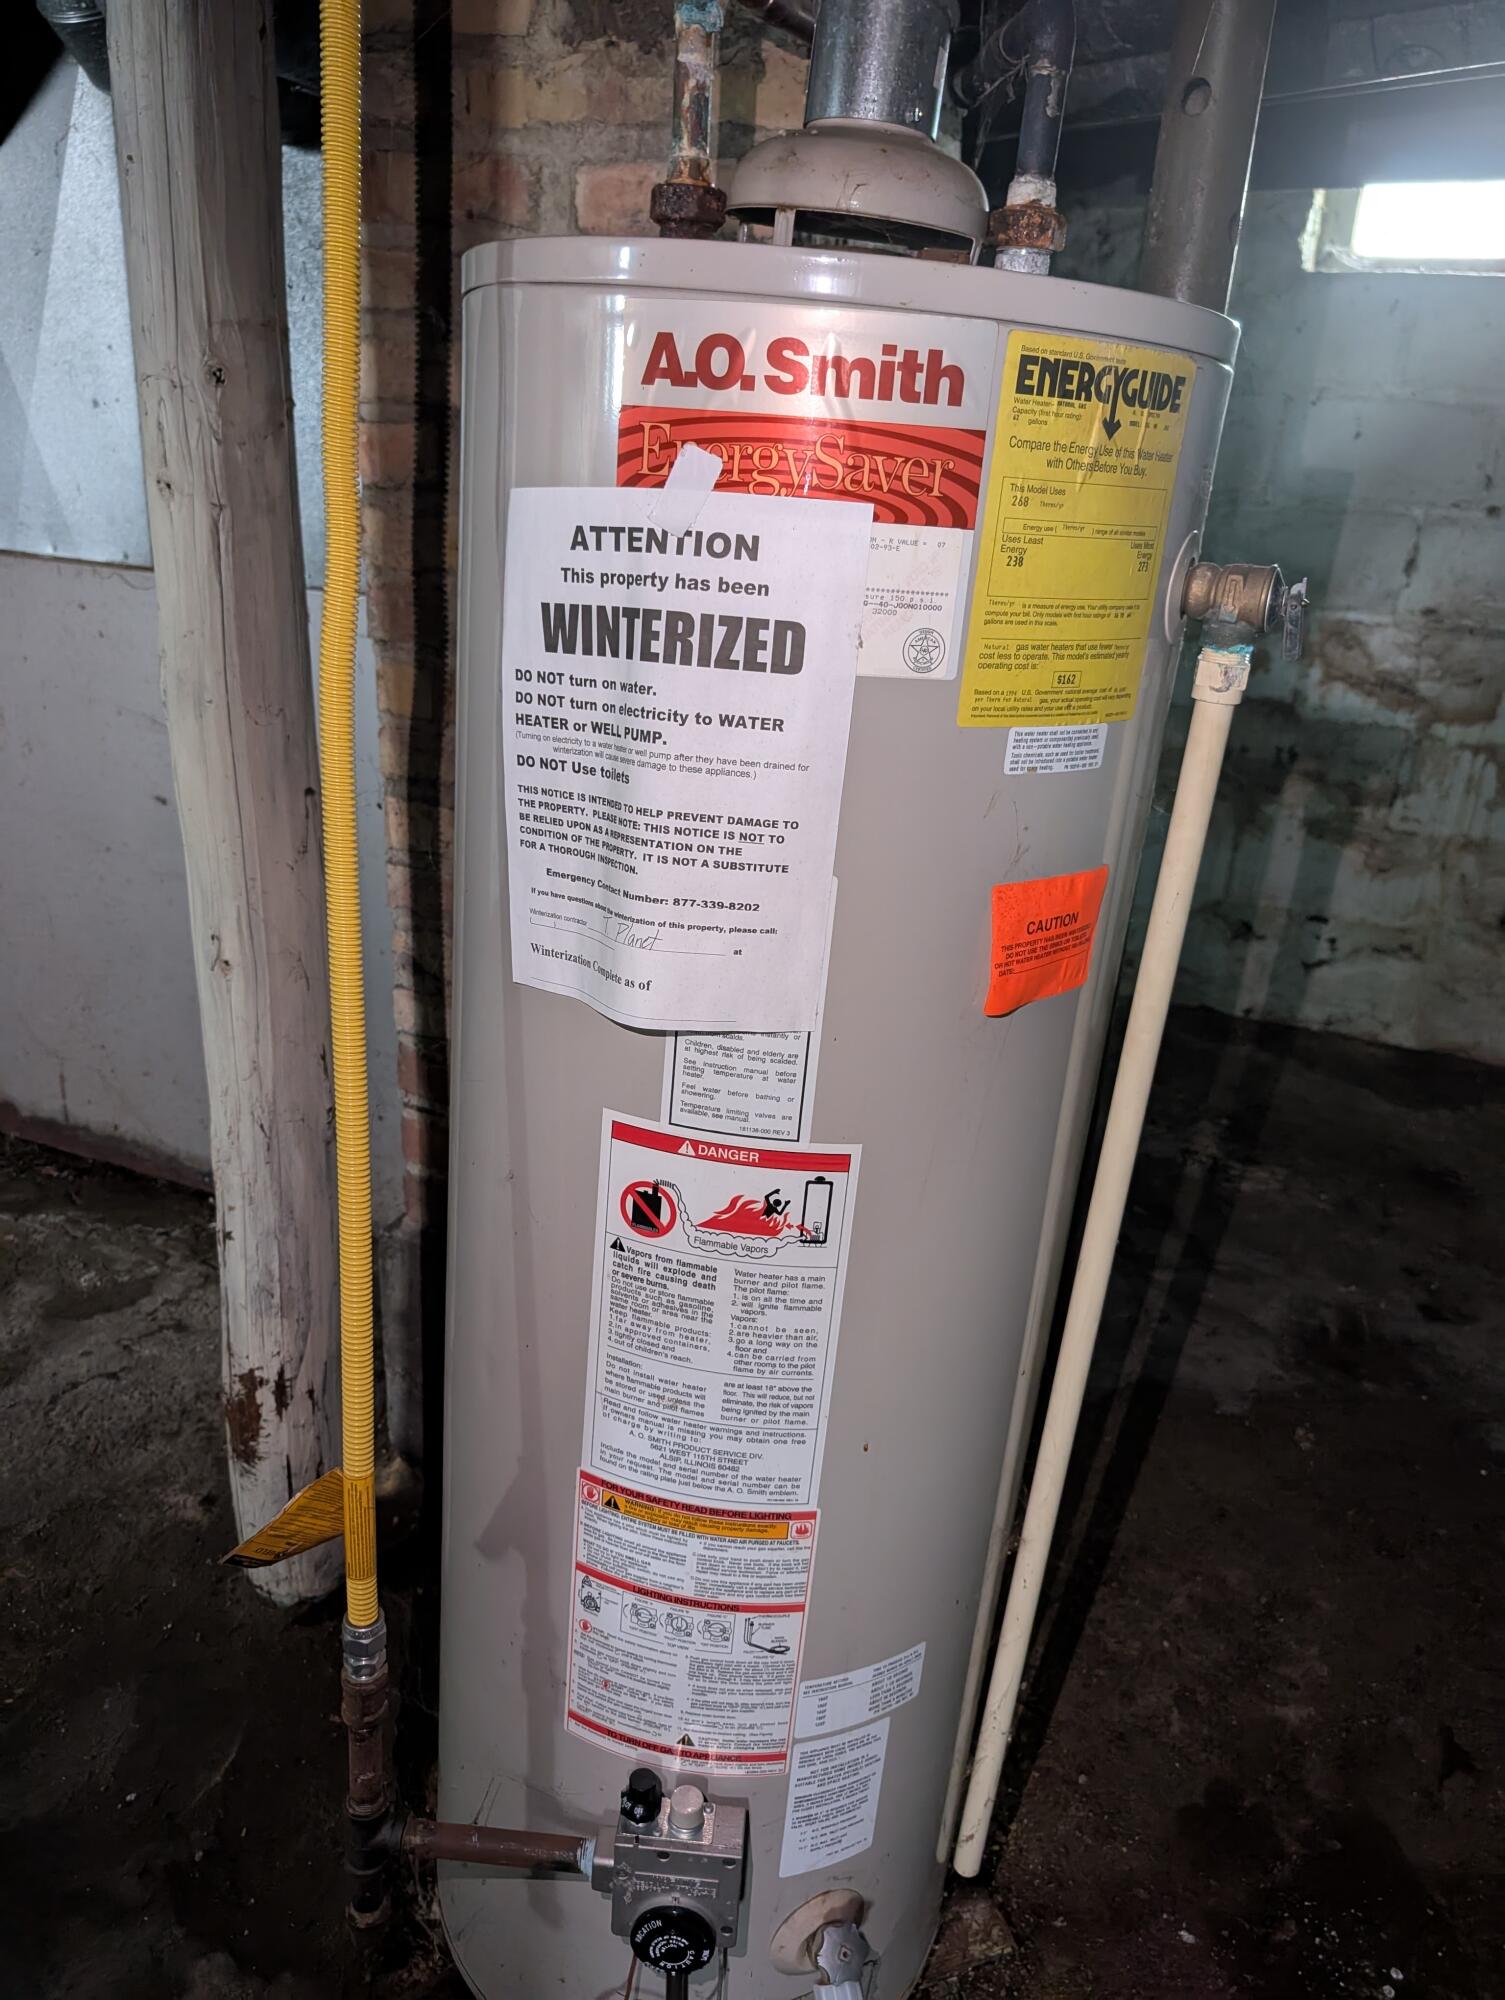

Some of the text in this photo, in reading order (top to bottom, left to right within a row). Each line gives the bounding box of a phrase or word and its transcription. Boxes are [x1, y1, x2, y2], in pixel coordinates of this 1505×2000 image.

[641, 332, 964, 406] A.O. Smith
[1015, 354, 1186, 413] ENERGYGUIDE
[638, 421, 955, 498] EergySaver
[1009, 435, 1173, 462] Compare the Energy Use of this Water Heater
[1046, 457, 1147, 477] with Others Before You Buy.
[1010, 483, 1066, 495] This Model Uses
[1011, 496, 1029, 507] 268
[570, 525, 760, 561] ATTENTION
[1000, 545, 1027, 556] Energy
[1001, 534, 1044, 544] Uses Least
[1006, 556, 1023, 567] 238
[1138, 562, 1149, 572] 273
[561, 568, 770, 596] This property has been
[541, 602, 806, 675] WINTERIZED
[978, 662, 1039, 671] operating cost is:
[1057, 674, 1075, 684] $162
[516, 669, 657, 696] DO NOT turn on water.
[516, 692, 784, 732] DO NOT turn on electricity to WATER
[516, 713, 668, 745] HEATER or WELL PUMP.
[517, 755, 630, 784] DO NOT Use toilets
[518, 785, 799, 830] THIS NOTICE IS INTENDED TO HELP PREVENT DAMAGE TO
[518, 798, 785, 844] THE PROPERTY. PLEASE NOTE: THIS NOTICE IS NOT TO
[519, 812, 742, 856] BE RELIED UPON AS A REPRESENTATION ON THE
[520, 826, 789, 874] CONDITION OF THE PROPERTY. IT IS NOT A SUBSTITUTE
[520, 839, 638, 875] FOR A THOROUGH INSPECTION.
[546, 868, 760, 912] Emergency Contact Number: 877-339-8202
[1027, 912, 1079, 935] CAUTION
[530, 942, 652, 991] Winterization Complete as of
[684, 1058, 797, 1078] See instruction manual before
[682, 1082, 696, 1090] Feel
[703, 1086, 721, 1094] water
[728, 1089, 748, 1098] before
[756, 1093, 780, 1102] bathing
[698, 1145, 760, 1163] DANGER
[694, 1237, 769, 1254] Flammable Vapors
[613, 1251, 716, 1282] liquids will explode and
[627, 1246, 717, 1273] Vapors from flammable
[612, 1261, 716, 1290] catch fire causing death
[621, 1272, 644, 1284] severe
[647, 1277, 669, 1290] burns.
[601, 1480, 792, 1520] FOR YOUR SAFETY READ BEFORE LIGHTING
[633, 1586, 740, 1612] LIGHTING INSTRUCTIONS
[608, 1729, 742, 1762] TO TURN OFF GA TO APPLIANCE
[635, 1920, 662, 1942] VACATION
